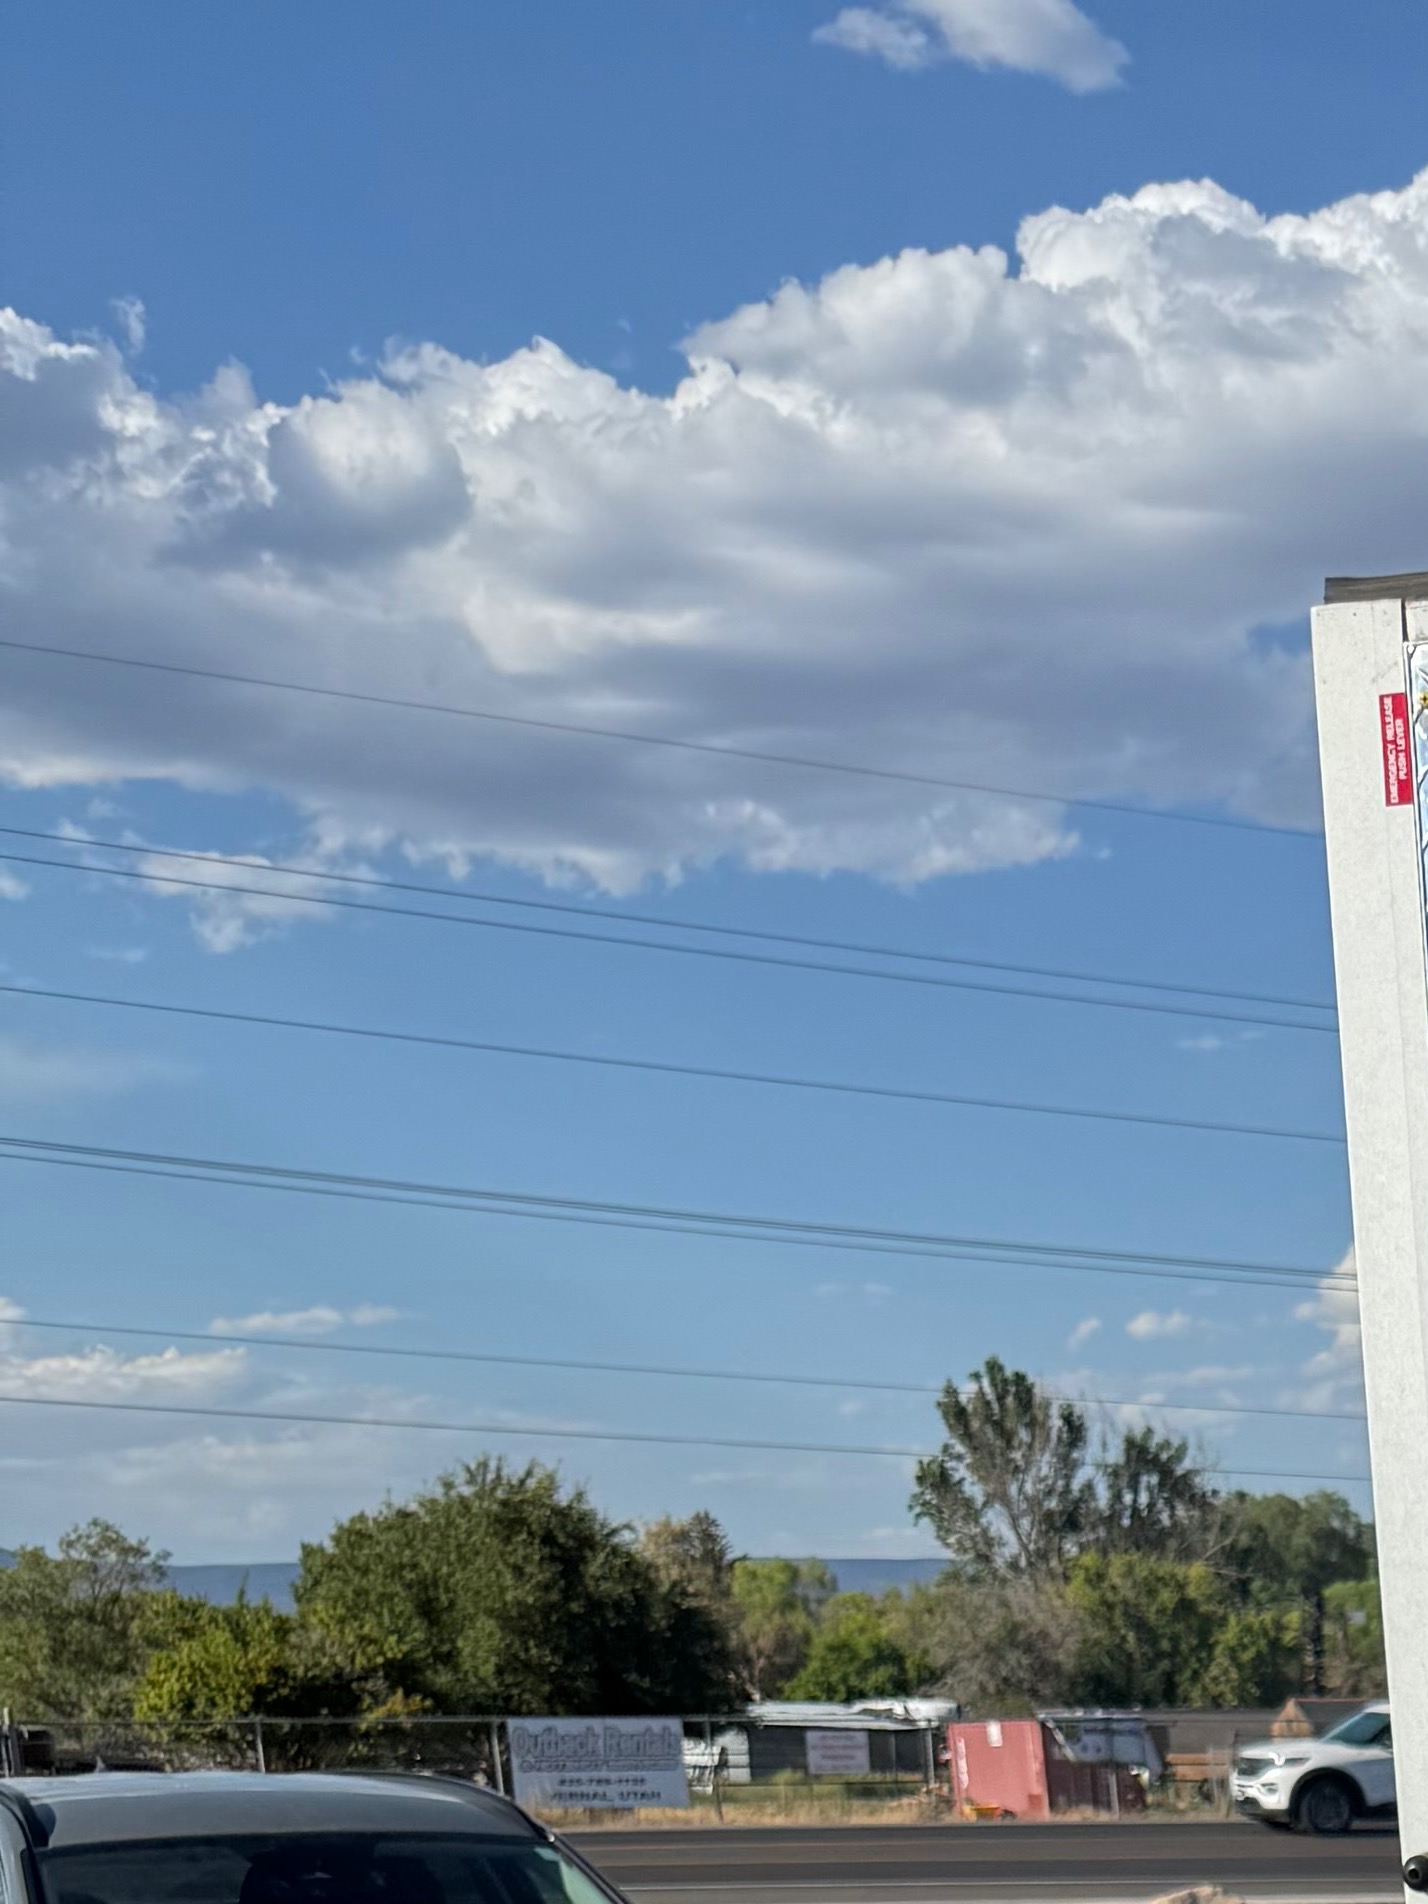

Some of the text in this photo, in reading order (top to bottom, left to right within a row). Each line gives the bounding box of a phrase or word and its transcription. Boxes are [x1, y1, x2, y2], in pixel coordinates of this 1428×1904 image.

[1384, 696, 1399, 803] EMERGENCY RELEASE
[1395, 718, 1408, 780] PUSH LEVER
